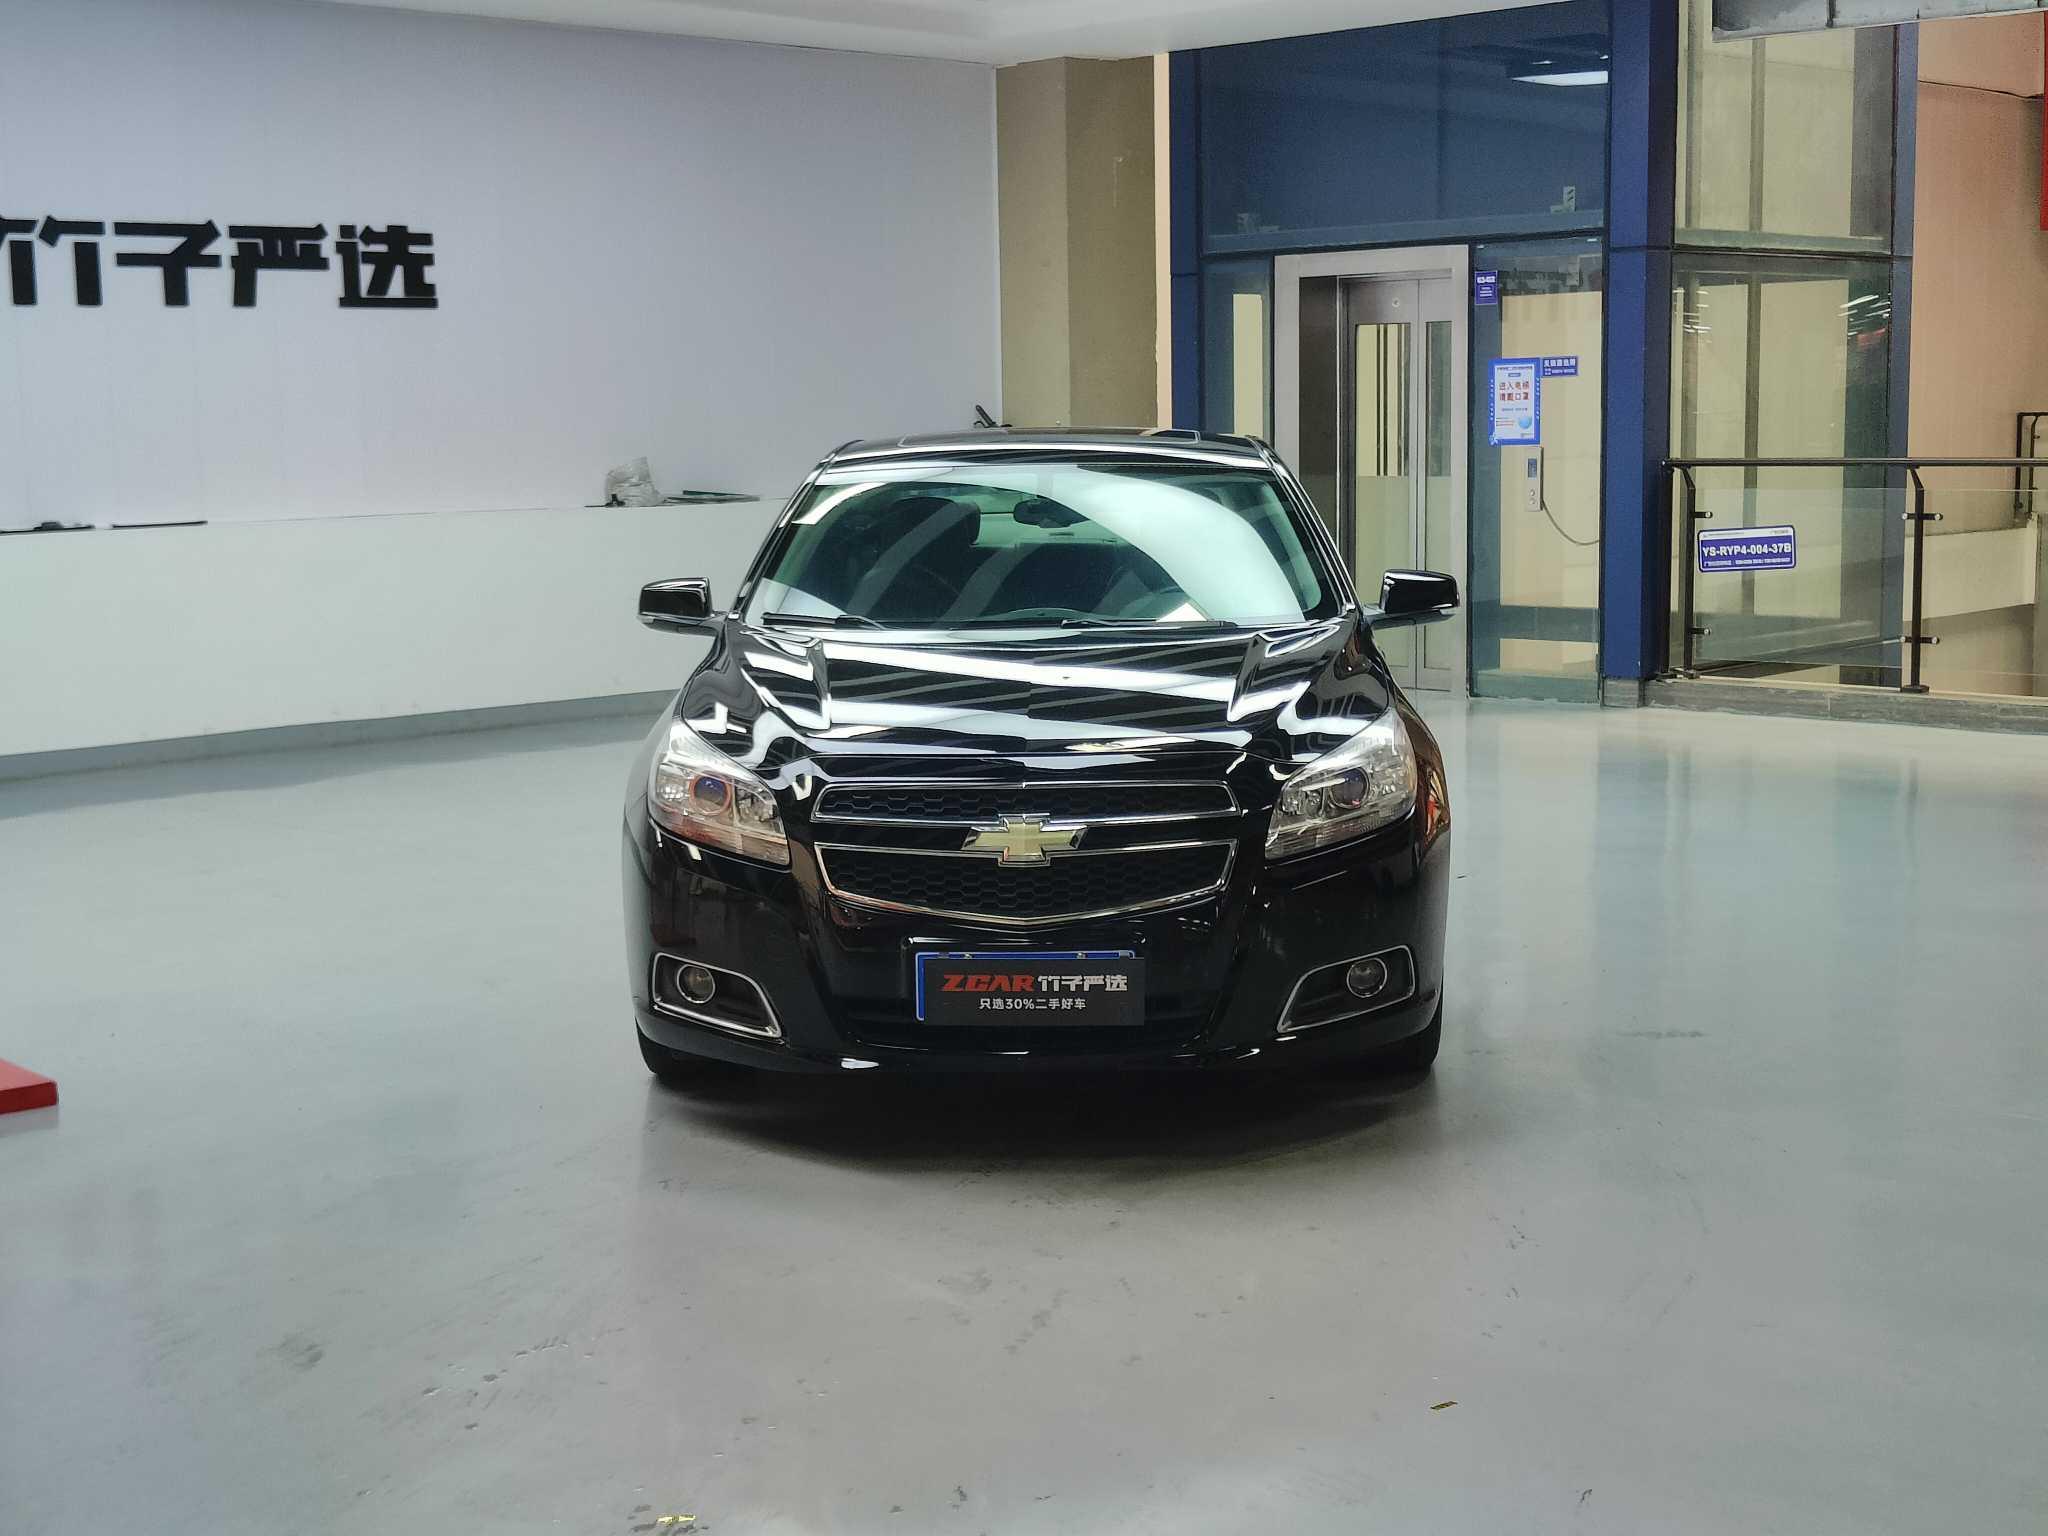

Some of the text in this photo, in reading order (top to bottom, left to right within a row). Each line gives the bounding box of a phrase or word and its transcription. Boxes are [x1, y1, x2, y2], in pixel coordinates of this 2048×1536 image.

[0, 215, 439, 308] 竹子严选
[1702, 543, 1792, 557] YS-RYP4-004-37B
[941, 974, 1128, 992] ZCAR 竹子严选
[979, 998, 1087, 1010] 只选30%二手好车
